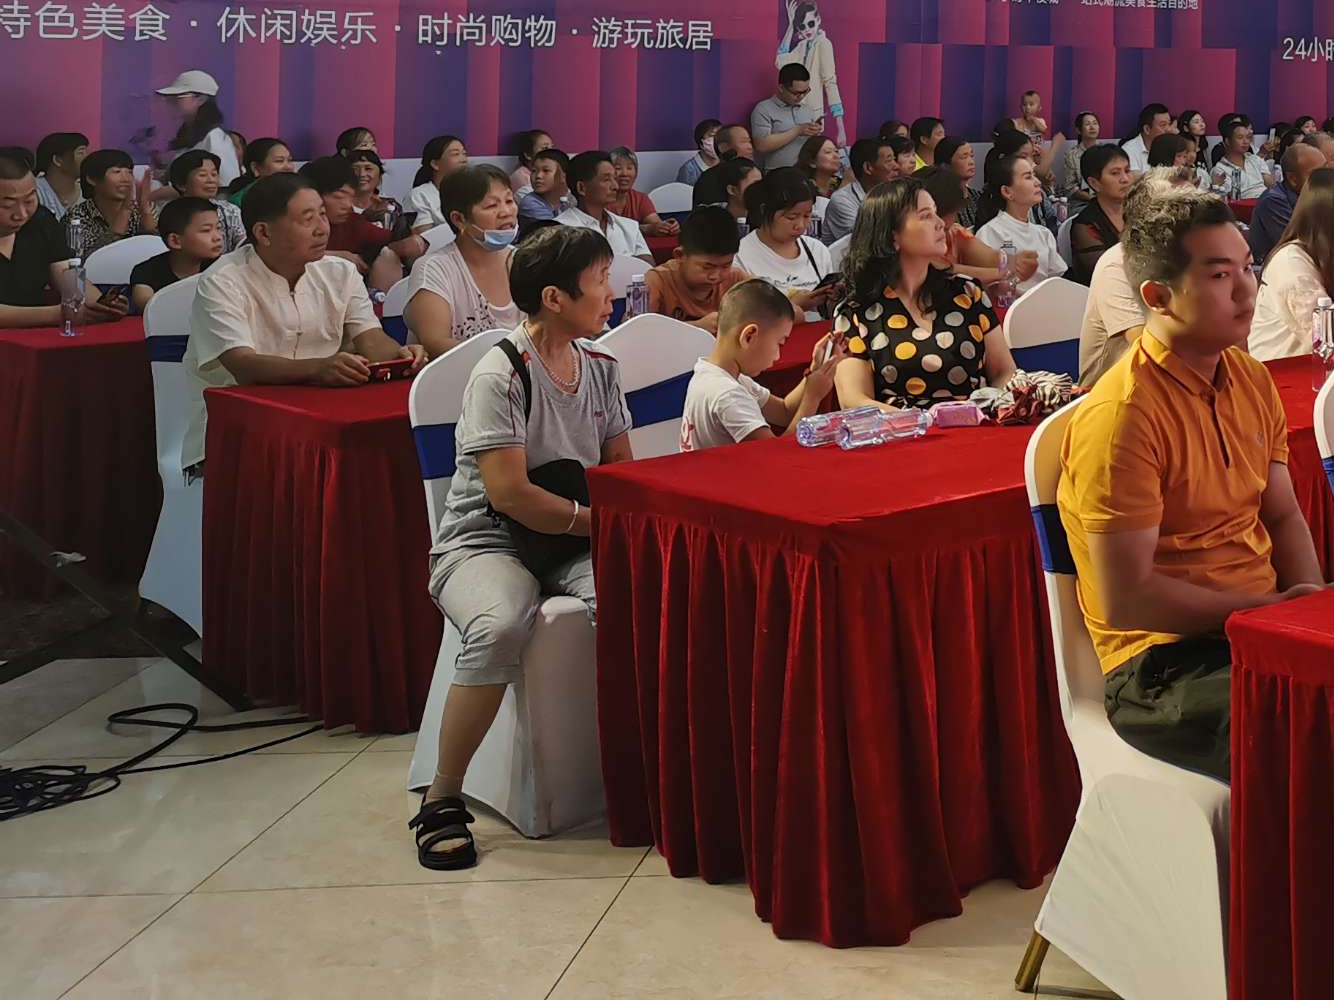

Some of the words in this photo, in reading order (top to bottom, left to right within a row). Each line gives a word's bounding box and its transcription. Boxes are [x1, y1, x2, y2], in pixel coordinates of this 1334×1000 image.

[217, 6, 377, 46] 休闲娱乐
[417, 12, 557, 48] 时尚购物
[591, 17, 713, 51] 游玩旅居
